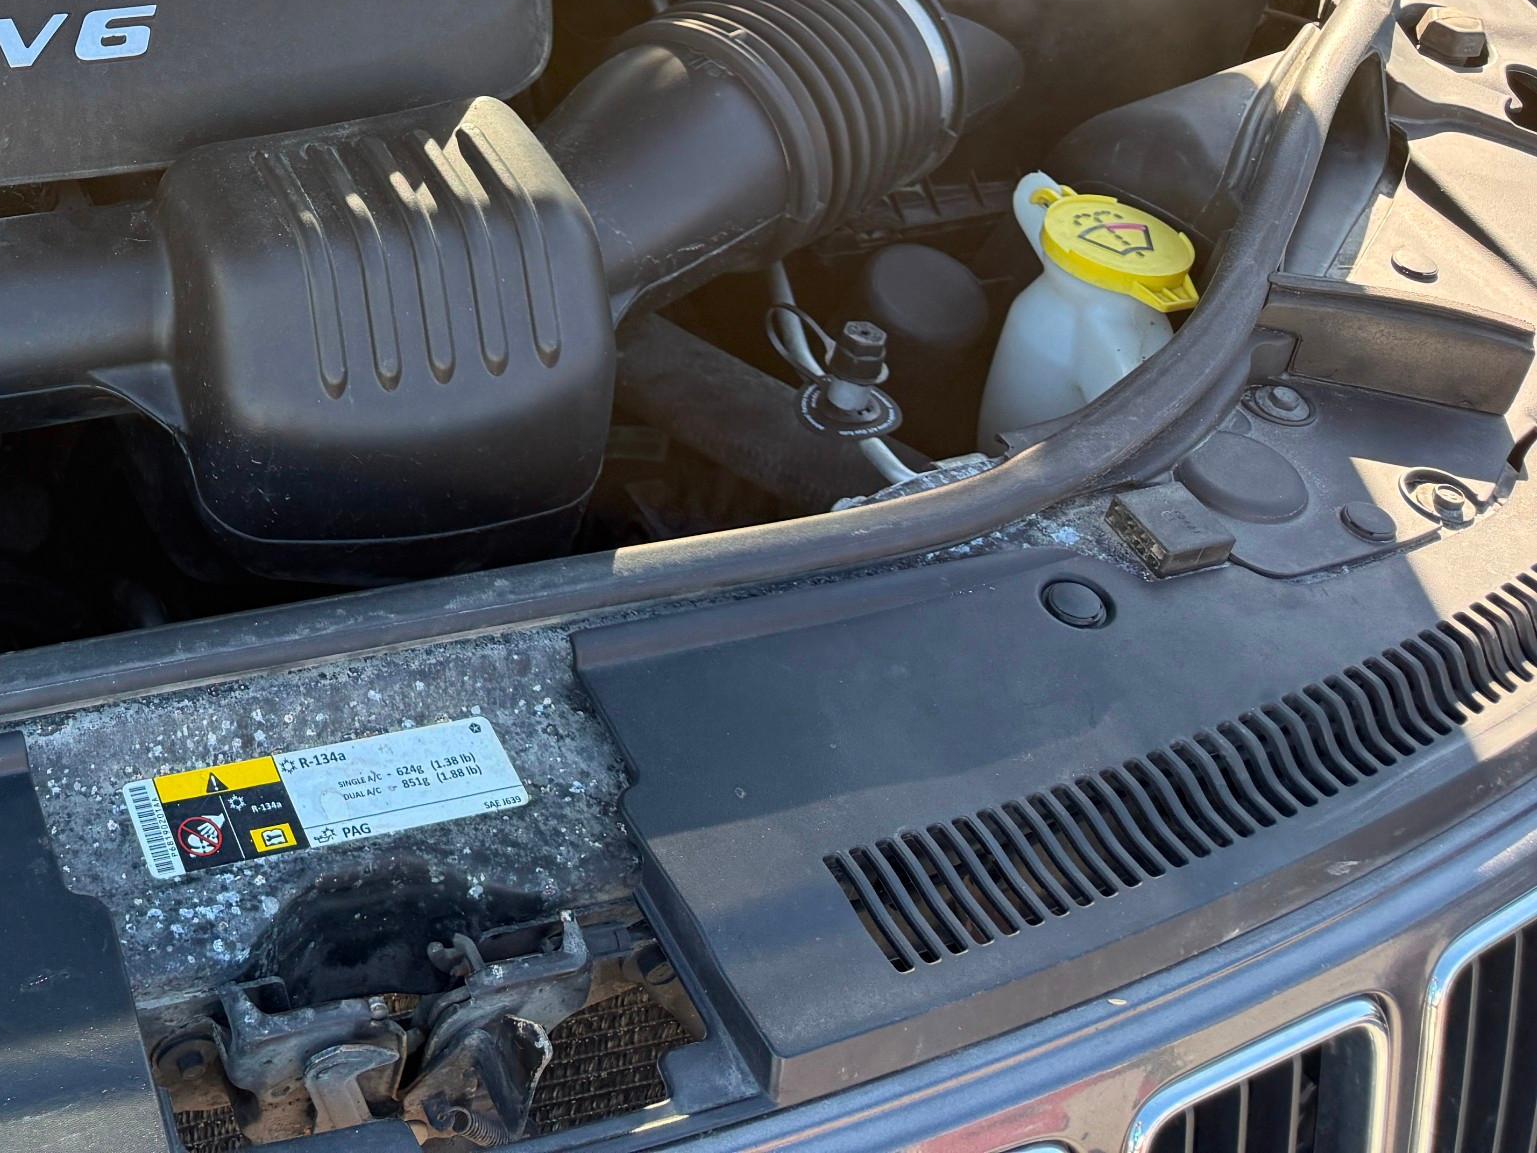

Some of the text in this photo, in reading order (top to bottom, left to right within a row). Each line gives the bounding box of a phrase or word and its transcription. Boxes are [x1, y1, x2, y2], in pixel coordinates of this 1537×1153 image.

[299, 751, 347, 769] R-134a
[338, 776, 366, 788] SINGLE
[368, 770, 382, 783] A/C
[396, 764, 425, 777] 624g
[430, 756, 458, 772] (1.38
[461, 752, 476, 764] lb)
[343, 789, 366, 801] DUAL
[367, 786, 382, 797] A/C
[402, 776, 431, 789] 851g
[436, 769, 465, 784] (1.88
[465, 764, 482, 776] lb)
[251, 801, 283, 813] R-134a
[484, 796, 522, 810] SAE J639
[343, 823, 372, 838] PAG
